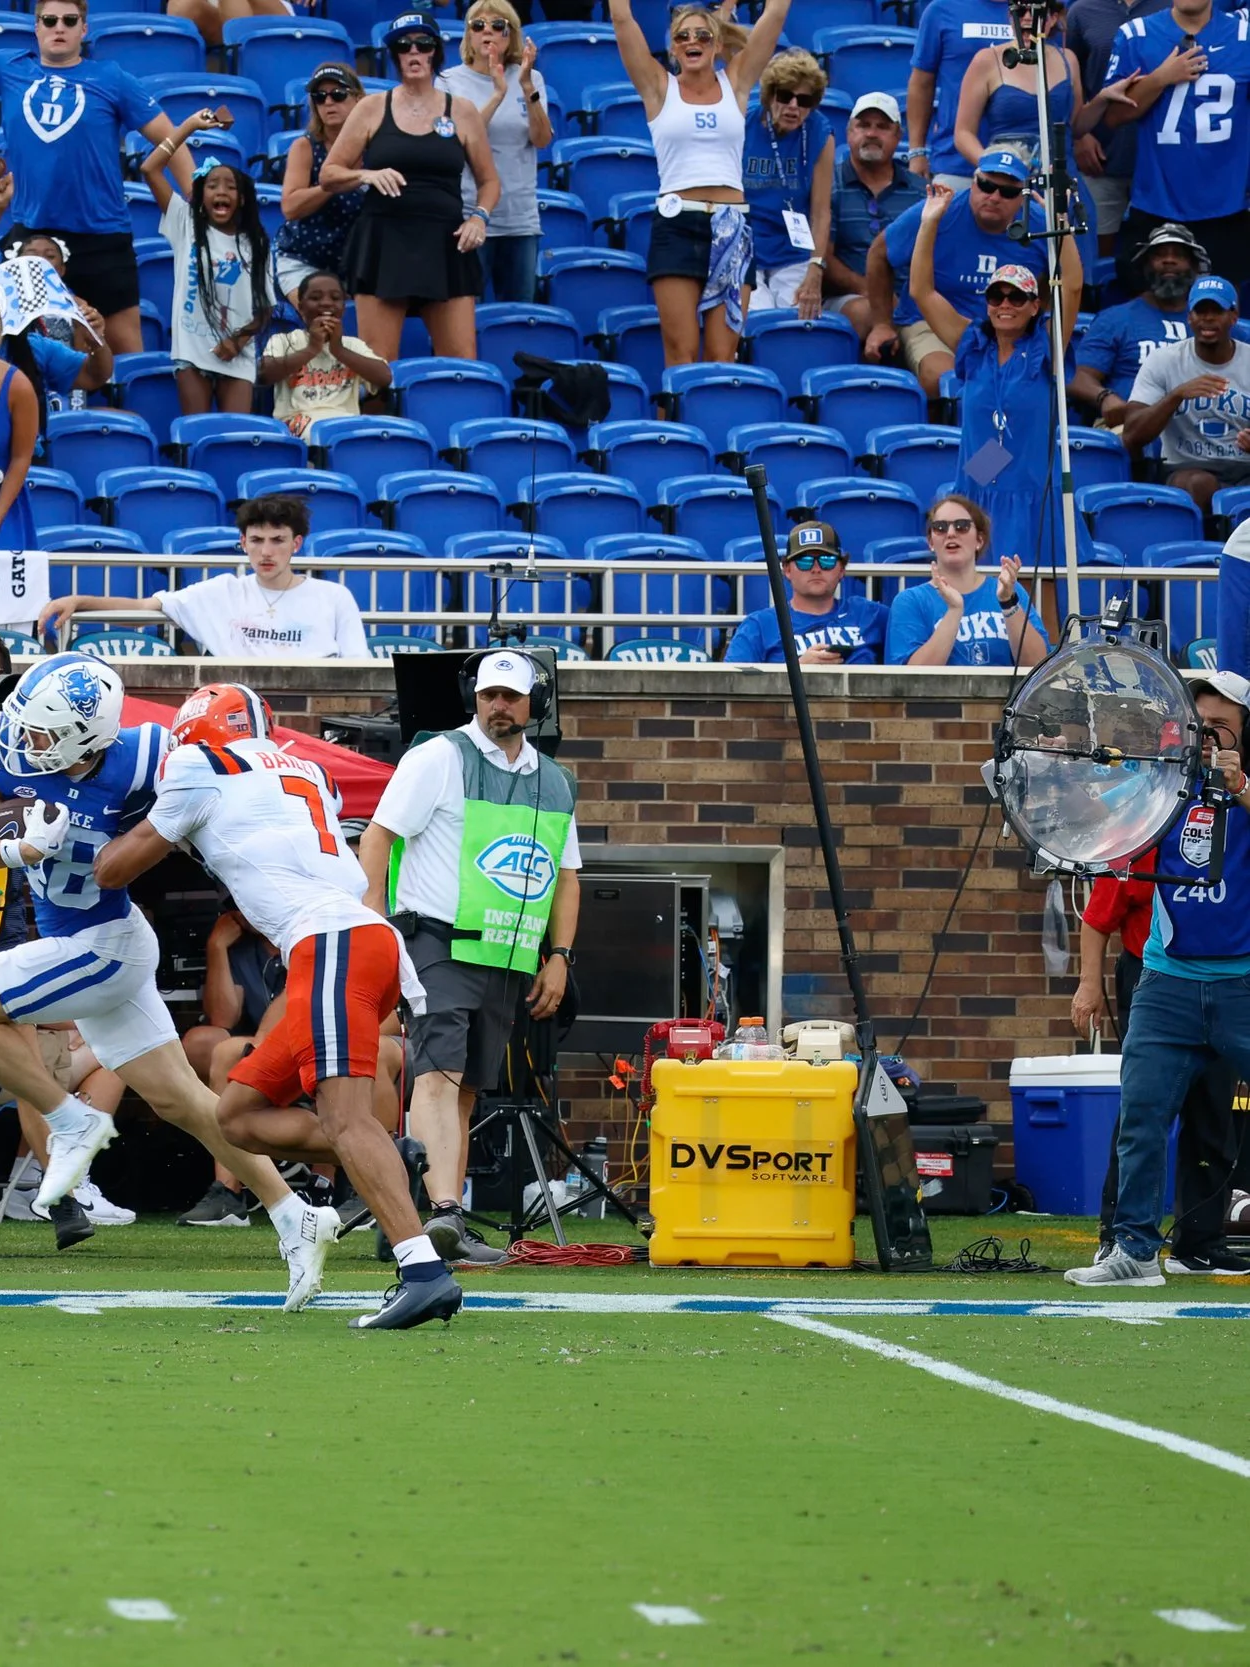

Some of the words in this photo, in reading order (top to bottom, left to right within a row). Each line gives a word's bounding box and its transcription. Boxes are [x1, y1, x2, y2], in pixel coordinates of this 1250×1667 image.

[980, 25, 1012, 38] DUK
[39, 102, 63, 125] D
[695, 112, 717, 129] 53
[1000, 154, 1013, 166] D
[976, 254, 998, 274] D
[1197, 279, 1224, 290] DUKE
[1161, 319, 1187, 341] D
[804, 531, 817, 543] D
[934, 611, 1010, 643] UKE
[67, 787, 79, 800] D
[278, 775, 339, 858] 7
[493, 851, 549, 878] ACC
[1173, 878, 1227, 904] 240
[751, 1172, 828, 1182] SOFTWARE
[301, 1210, 318, 1244] NIKE
